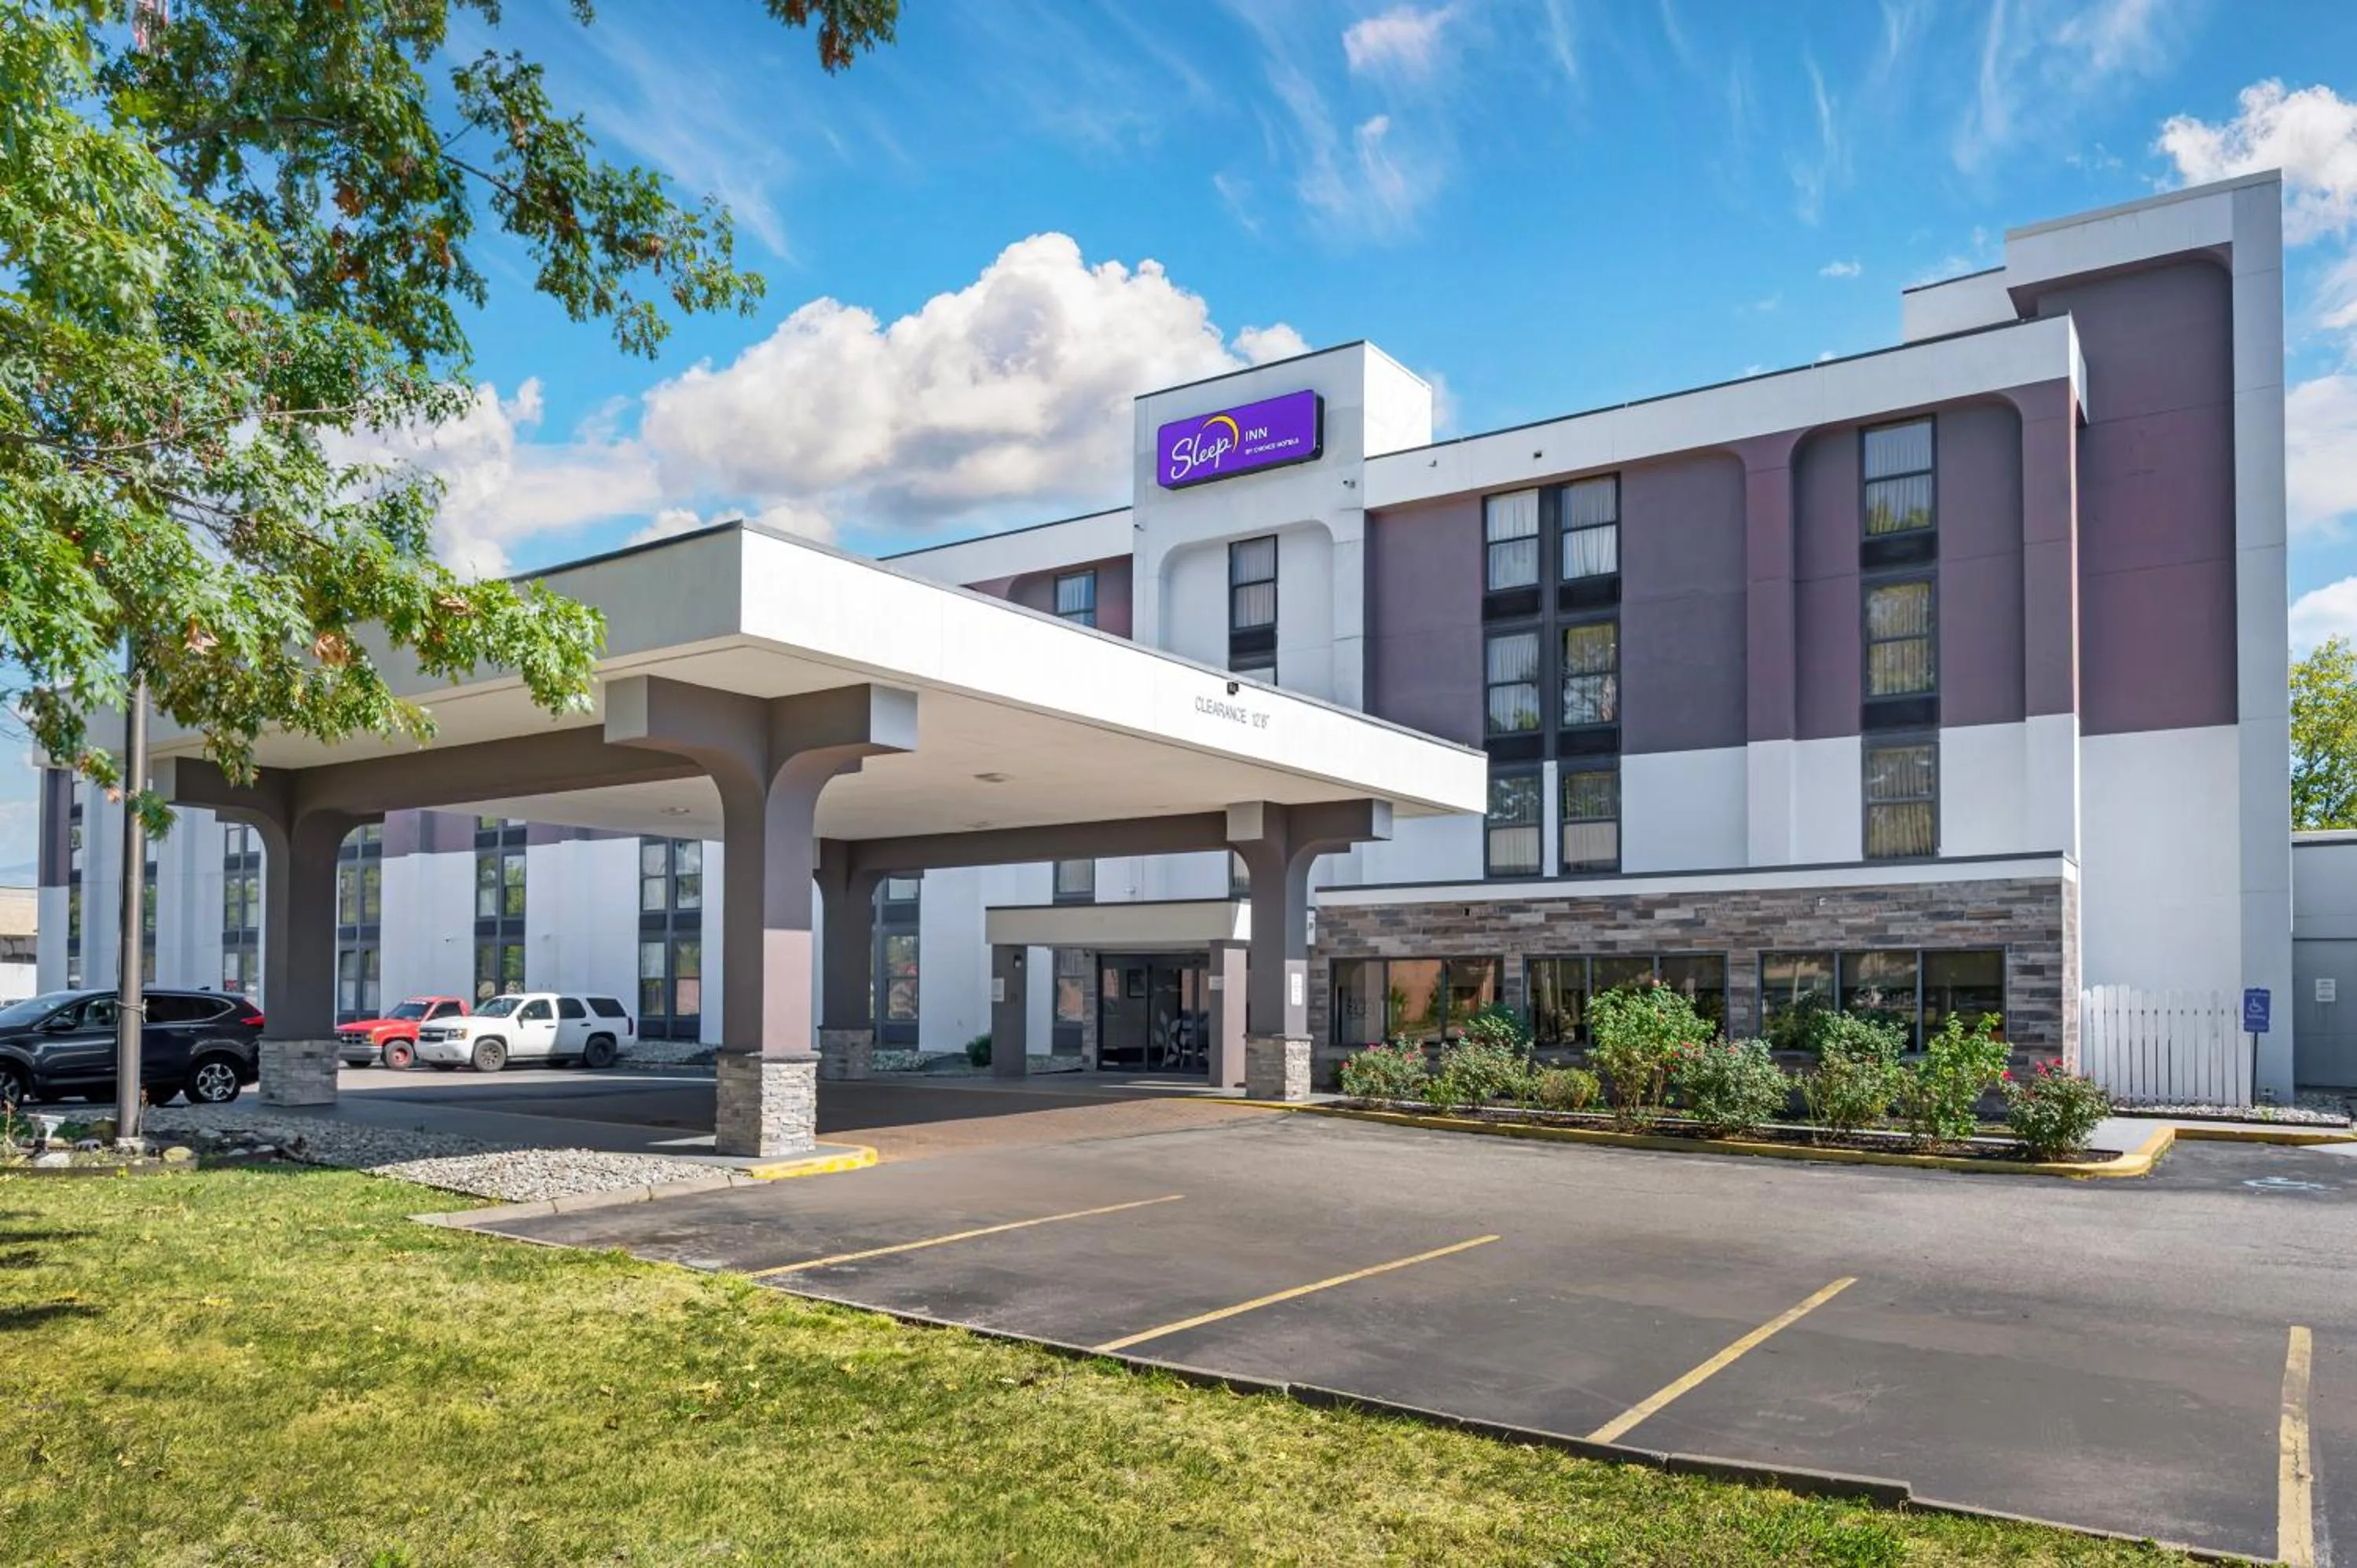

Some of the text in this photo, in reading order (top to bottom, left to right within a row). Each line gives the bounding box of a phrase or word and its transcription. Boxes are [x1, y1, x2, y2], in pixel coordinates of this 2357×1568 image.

[1170, 427, 1268, 480] Sleep INN
[1194, 695, 1248, 724] CLEARANCE
